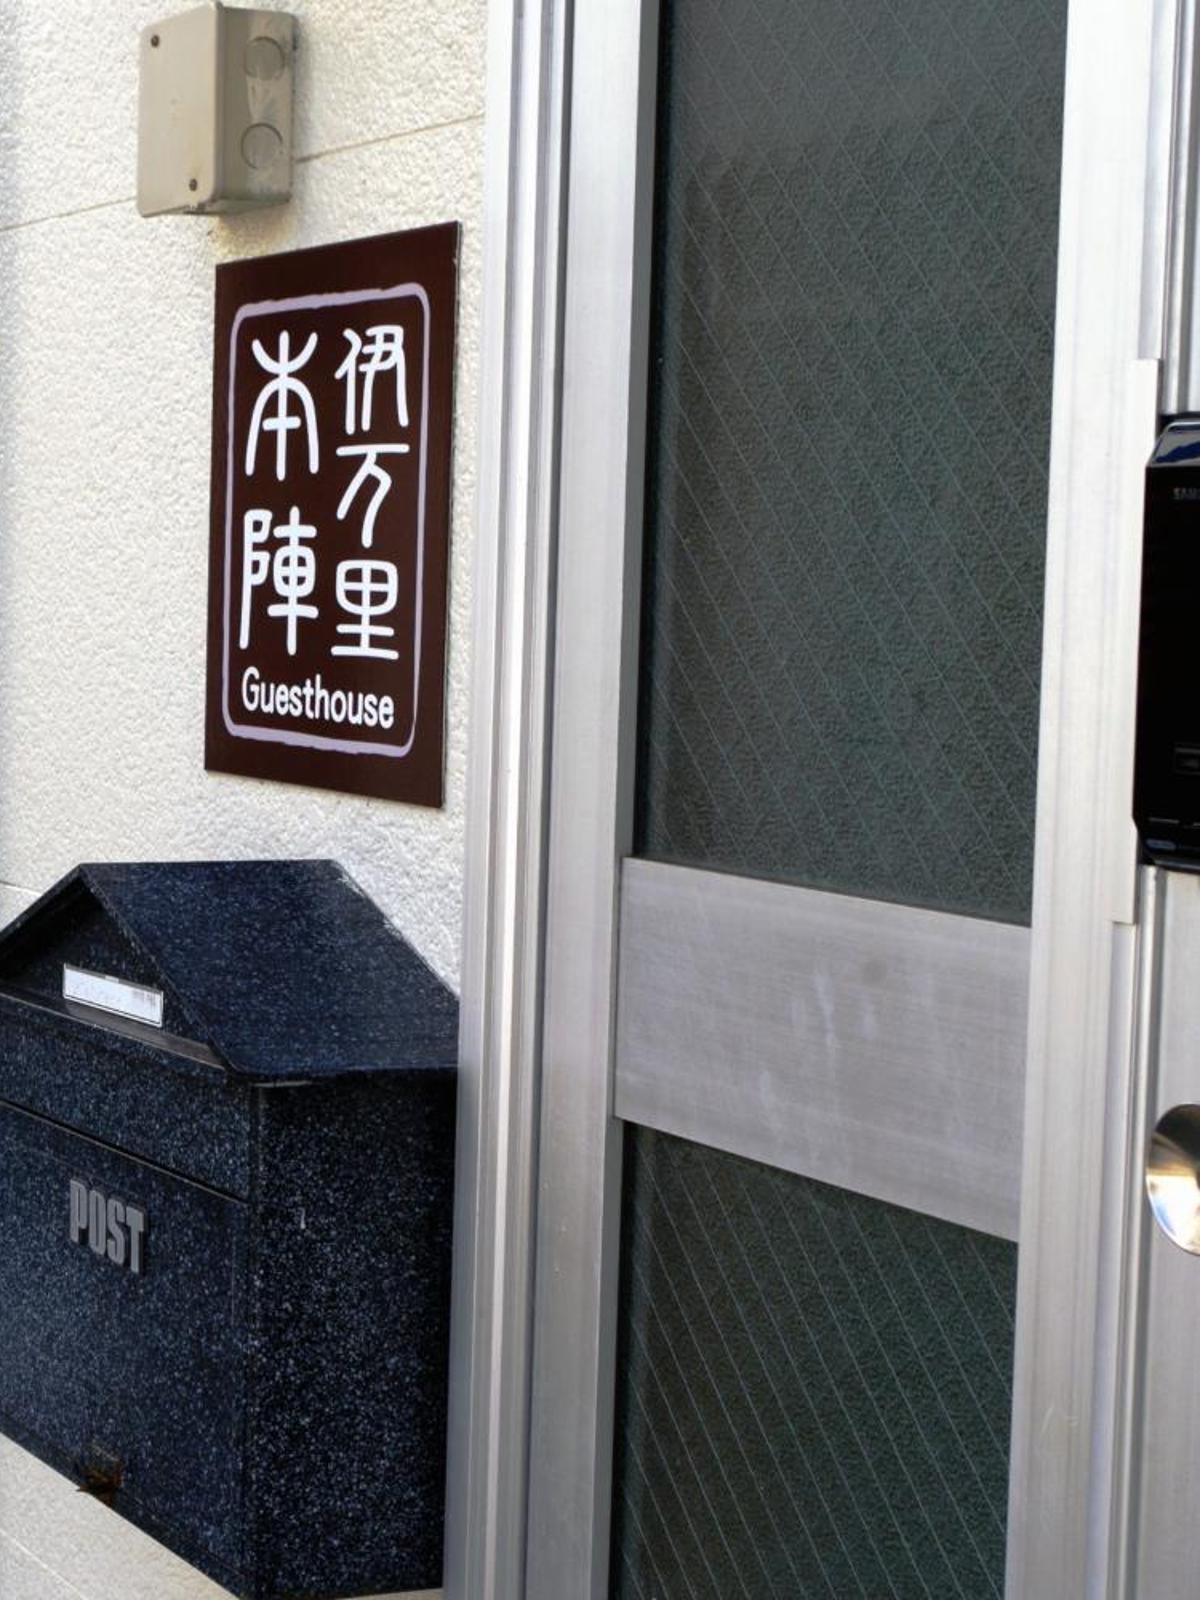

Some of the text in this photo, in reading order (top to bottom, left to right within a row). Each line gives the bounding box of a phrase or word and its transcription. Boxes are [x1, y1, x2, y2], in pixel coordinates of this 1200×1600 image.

[239, 330, 320, 656] 本陣
[331, 324, 409, 659] 伊万里
[242, 666, 395, 729] Guesthouse
[69, 1178, 144, 1274] POST
